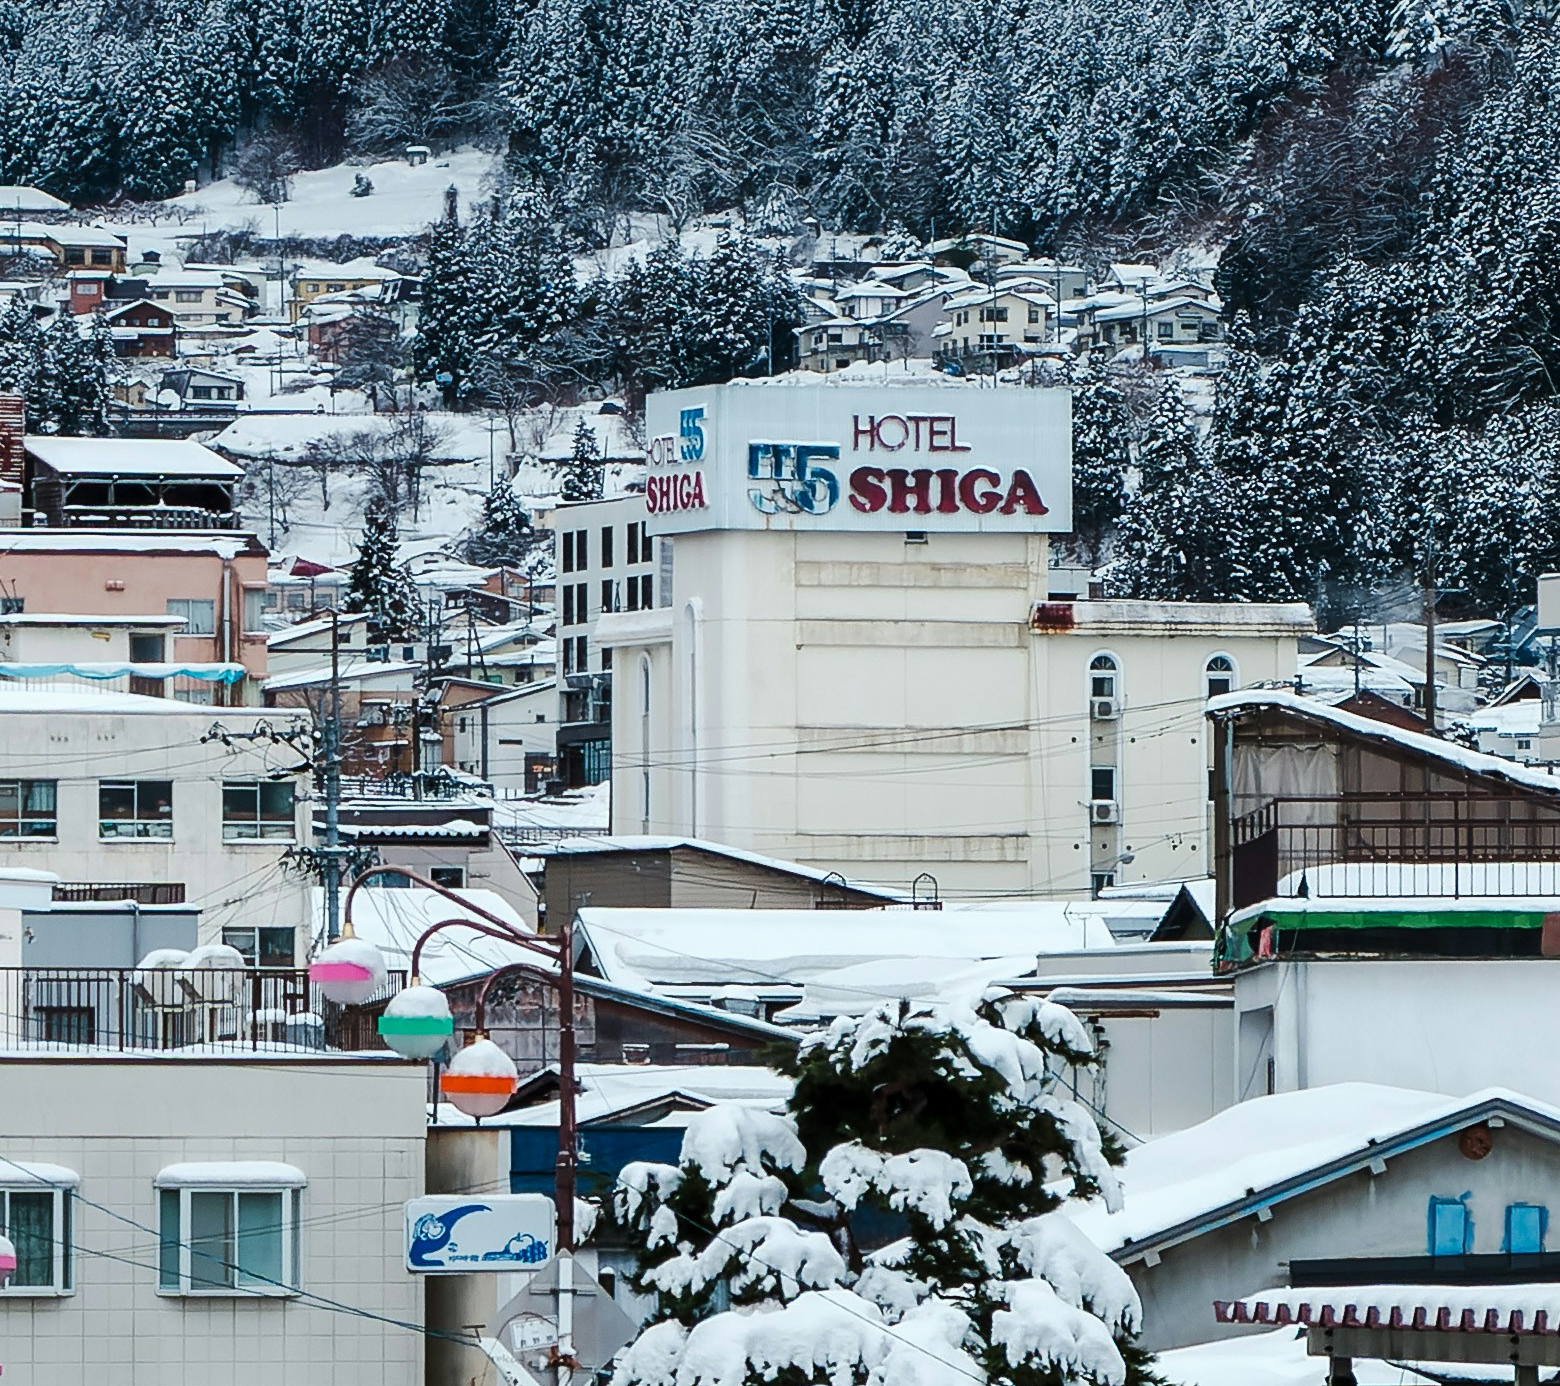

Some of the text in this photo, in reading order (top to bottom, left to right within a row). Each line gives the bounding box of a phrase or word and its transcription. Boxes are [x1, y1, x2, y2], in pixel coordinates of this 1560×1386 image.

[853, 413, 972, 452] HOTEL
[646, 470, 707, 515] SHIGA
[849, 466, 1048, 516] SHIGA
